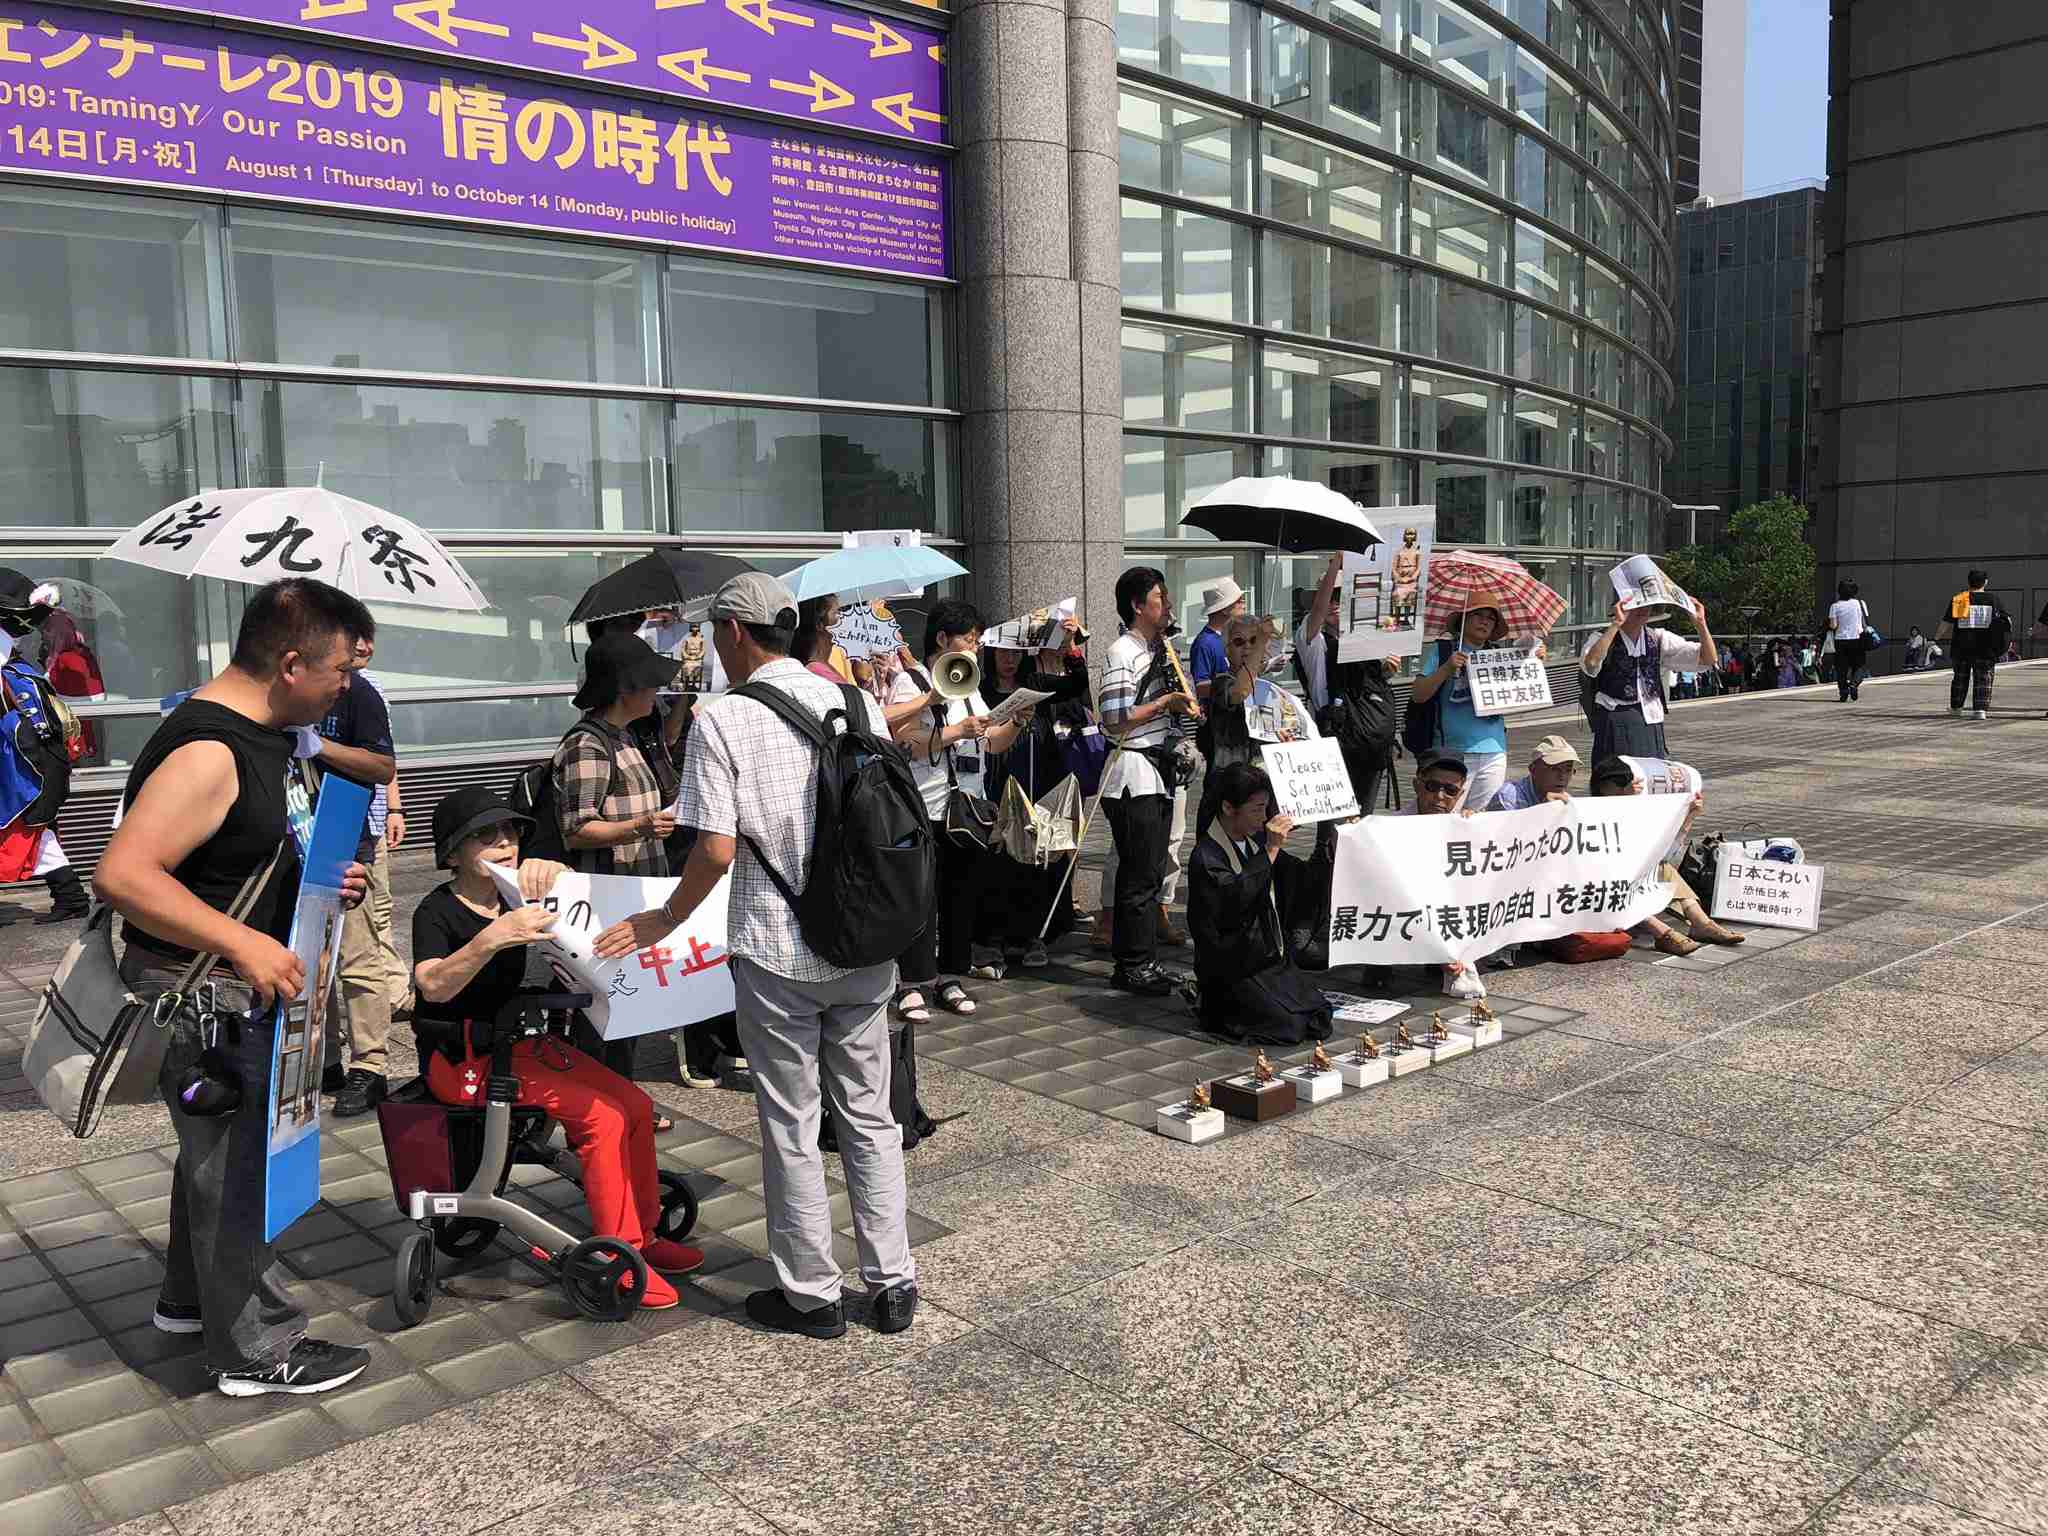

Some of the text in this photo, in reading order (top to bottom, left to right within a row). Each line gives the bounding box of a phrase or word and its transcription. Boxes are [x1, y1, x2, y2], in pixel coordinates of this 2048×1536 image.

[296, 119, 407, 155] Passion
[428, 77, 732, 196] 情の時代
[225, 156, 737, 235] August 1 [Thursday] to October 14 [Monday, public holiday]
[1476, 663, 1540, 685] 日韓友好
[1480, 683, 1545, 706] 日中友好
[1273, 751, 1325, 774] Please
[1315, 781, 1344, 799] again
[1444, 822, 1623, 878] 見たかったのに!!
[1728, 863, 1811, 885] 日本こわい
[1742, 885, 1791, 900] 恐怖日本
[637, 935, 730, 988] 中止
